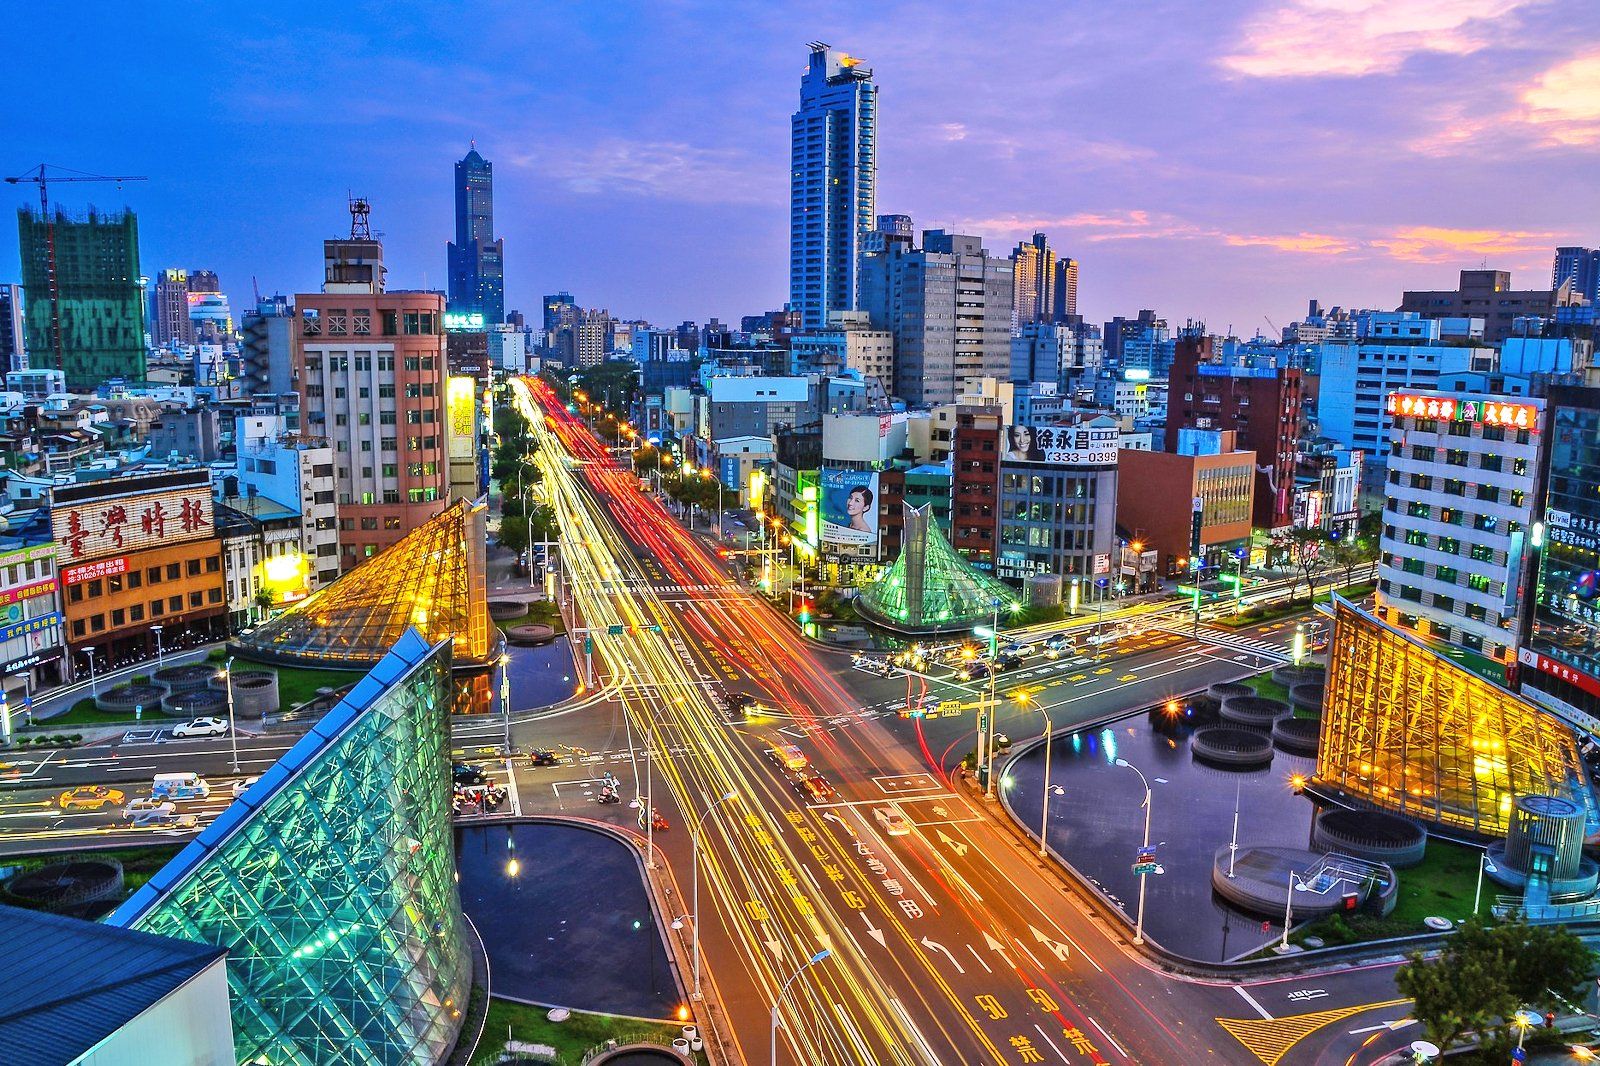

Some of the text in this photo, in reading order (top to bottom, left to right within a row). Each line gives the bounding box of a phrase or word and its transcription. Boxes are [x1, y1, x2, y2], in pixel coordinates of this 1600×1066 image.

[1485, 405, 1528, 426] 大飯店
[1038, 428, 1089, 450] 徐永昌
[1053, 452, 1117, 463] 333-0399
[62, 497, 211, 558] 臺灣時報
[974, 994, 1009, 1020] 50
[1025, 988, 1060, 1013] 50
